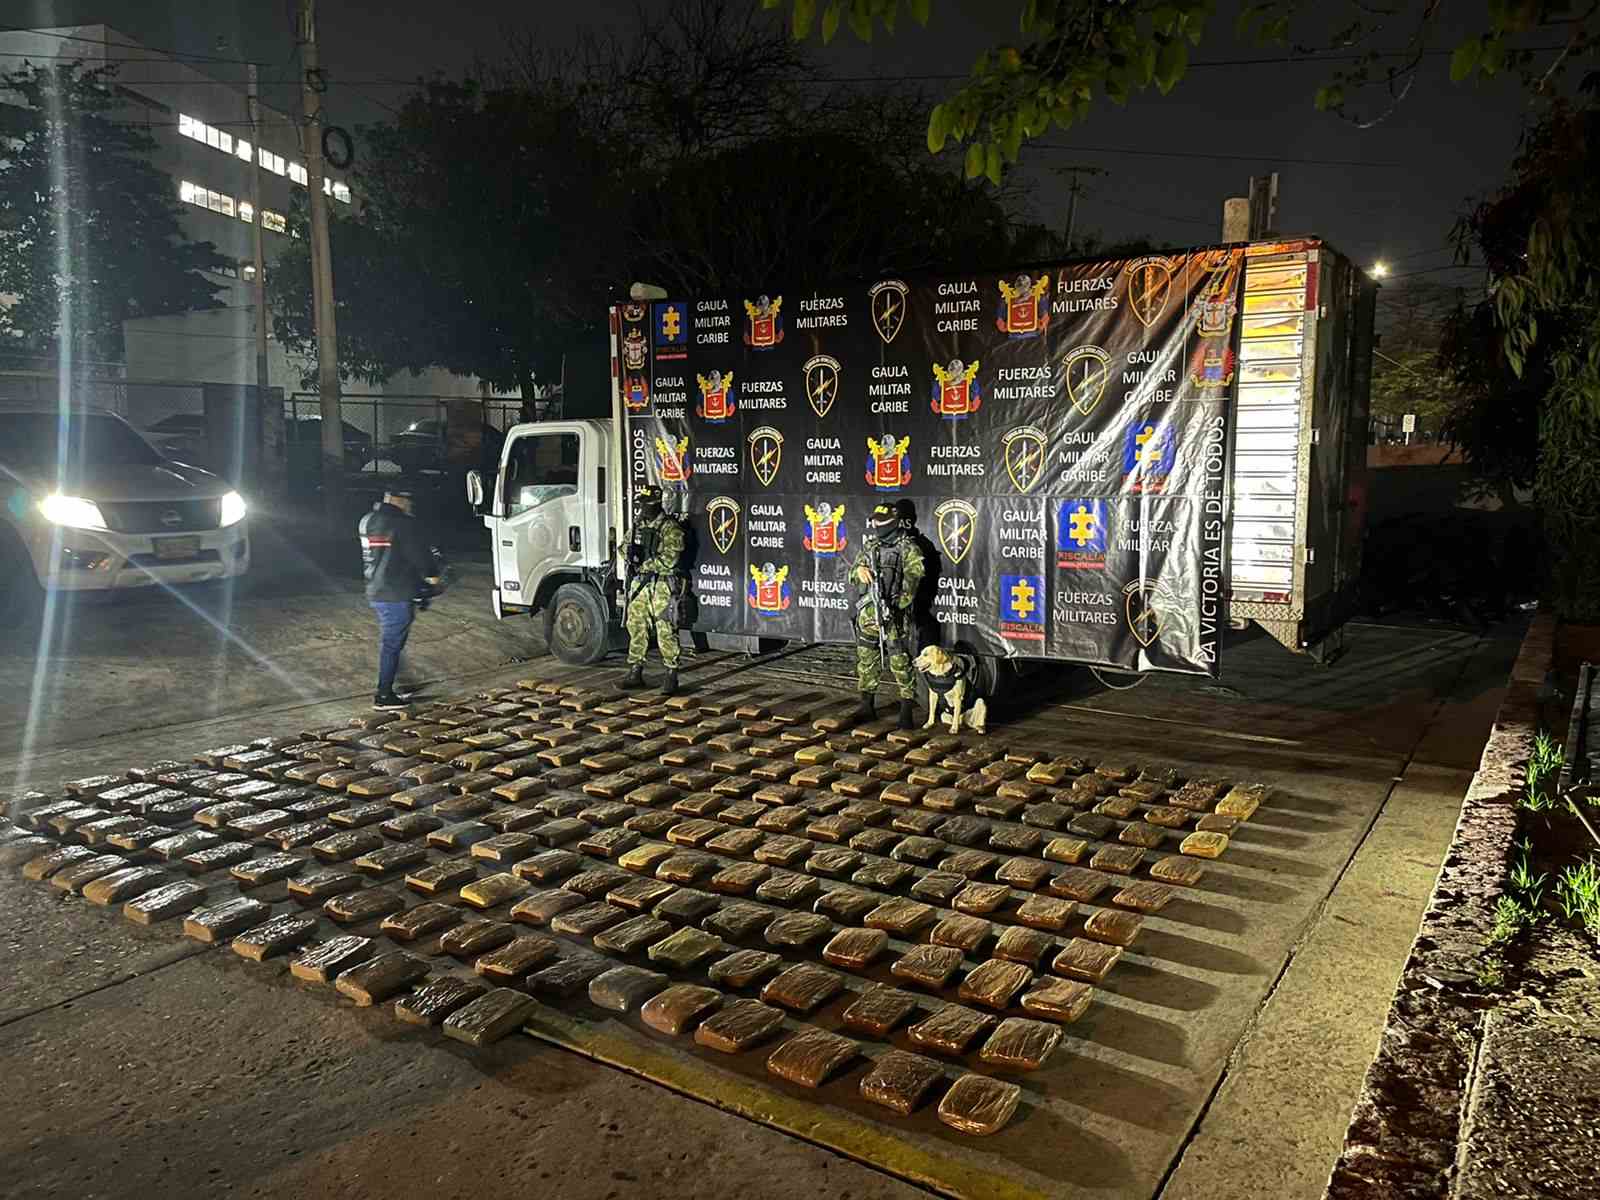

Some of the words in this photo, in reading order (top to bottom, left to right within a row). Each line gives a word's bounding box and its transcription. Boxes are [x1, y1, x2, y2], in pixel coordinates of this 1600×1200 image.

[938, 281, 977, 295] GAULA
[1057, 277, 1113, 293] FUERZAS
[697, 300, 728, 311] GAULA
[800, 298, 844, 311] FUERZAS
[935, 300, 980, 314] MILITAR
[1052, 296, 1118, 313] MILITARES
[695, 316, 731, 328] MILITAR
[796, 314, 847, 328] MILITARES
[937, 318, 978, 332] CARIBE
[696, 333, 729, 344] CARIBE
[871, 366, 908, 378] GAULA
[998, 366, 1051, 380] FUERZAS
[655, 377, 684, 387] GAULA
[741, 381, 783, 392] FUERZAS
[869, 384, 911, 396] MILITAR
[993, 385, 1055, 399] MILITARES
[653, 393, 687, 403] MILITAR
[738, 398, 787, 409] MILITARES
[655, 408, 685, 418] CARIBE
[871, 401, 909, 413] CARIBE
[807, 438, 840, 449] GAULA
[1063, 431, 1113, 444] GAUL
[696, 447, 735, 458] FUERZAS
[931, 446, 980, 458] FUERZAS
[1206, 416, 1224, 480] TODOS
[633, 429, 645, 480] TODOS
[804, 454, 844, 466] MILITAR
[693, 463, 738, 474] MILITARES
[927, 463, 984, 476] MILITARES
[806, 471, 841, 483] CARIBE
[1061, 470, 1106, 482] CARIBE
[1205, 490, 1222, 513] DE
[751, 504, 783, 516] GAULA
[1003, 510, 1042, 522] GAULA
[749, 520, 786, 532] MILITAR
[1205, 520, 1221, 540] ES
[1000, 528, 1048, 541] MILITAR
[751, 536, 784, 548] CARIBE
[1002, 546, 1044, 558] CARIBE
[700, 564, 731, 576] GAULA
[698, 580, 733, 592] MILITAR
[802, 580, 845, 593] FUERZAS
[938, 577, 975, 590] GAULA
[1201, 547, 1220, 635] VICTORIA
[700, 595, 732, 607] CARIBE
[799, 596, 848, 610] MILITARES
[934, 594, 978, 608] MILITAR
[1057, 591, 1113, 606] FUERZAS
[936, 611, 976, 625] CARIBE
[1052, 609, 1118, 625] MILITARES
[1201, 641, 1216, 663] LA
